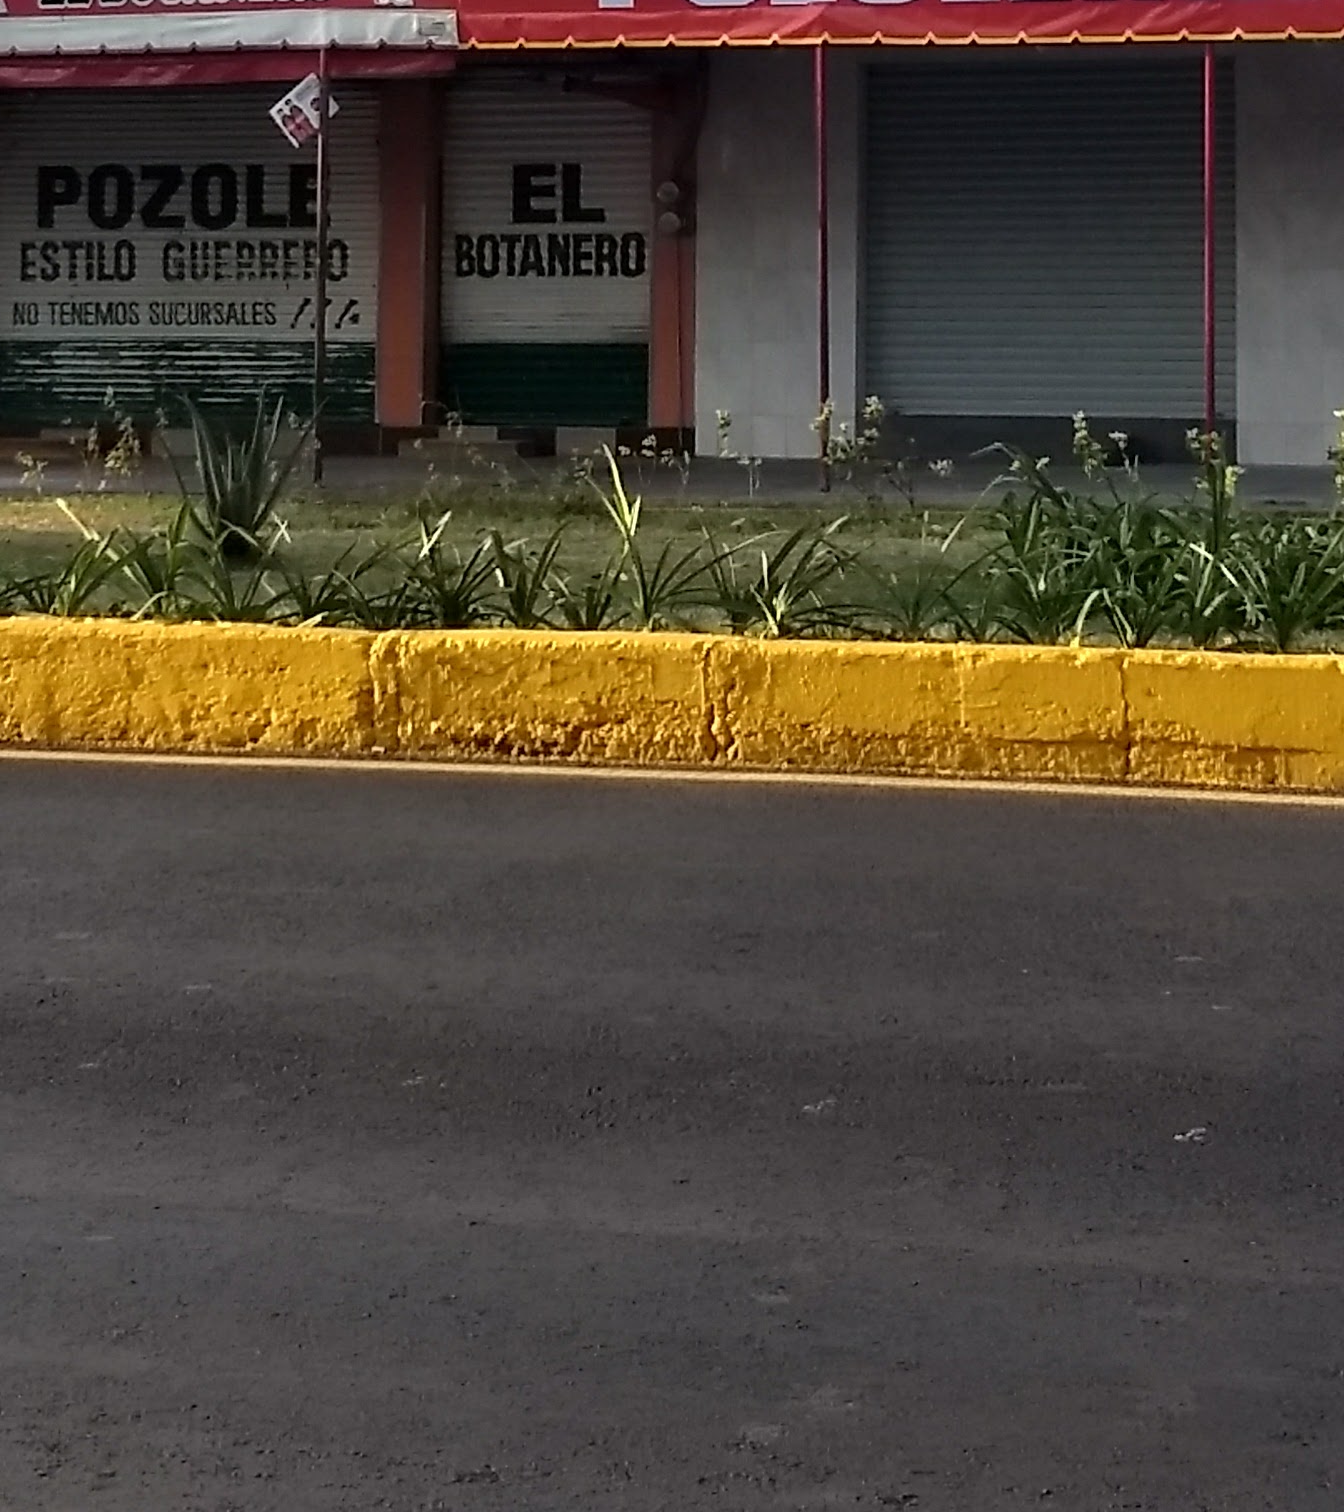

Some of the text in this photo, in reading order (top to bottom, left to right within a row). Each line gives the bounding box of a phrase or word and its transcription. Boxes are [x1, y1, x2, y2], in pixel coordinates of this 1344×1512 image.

[37, 163, 331, 230] POZOLE
[512, 163, 605, 224] EL
[20, 239, 350, 283] ESTILO GUERRERO
[455, 232, 646, 278] BOTANERO
[12, 302, 39, 327] NO
[48, 301, 141, 327] TENEMOS
[149, 301, 277, 327] SUCURSALES
